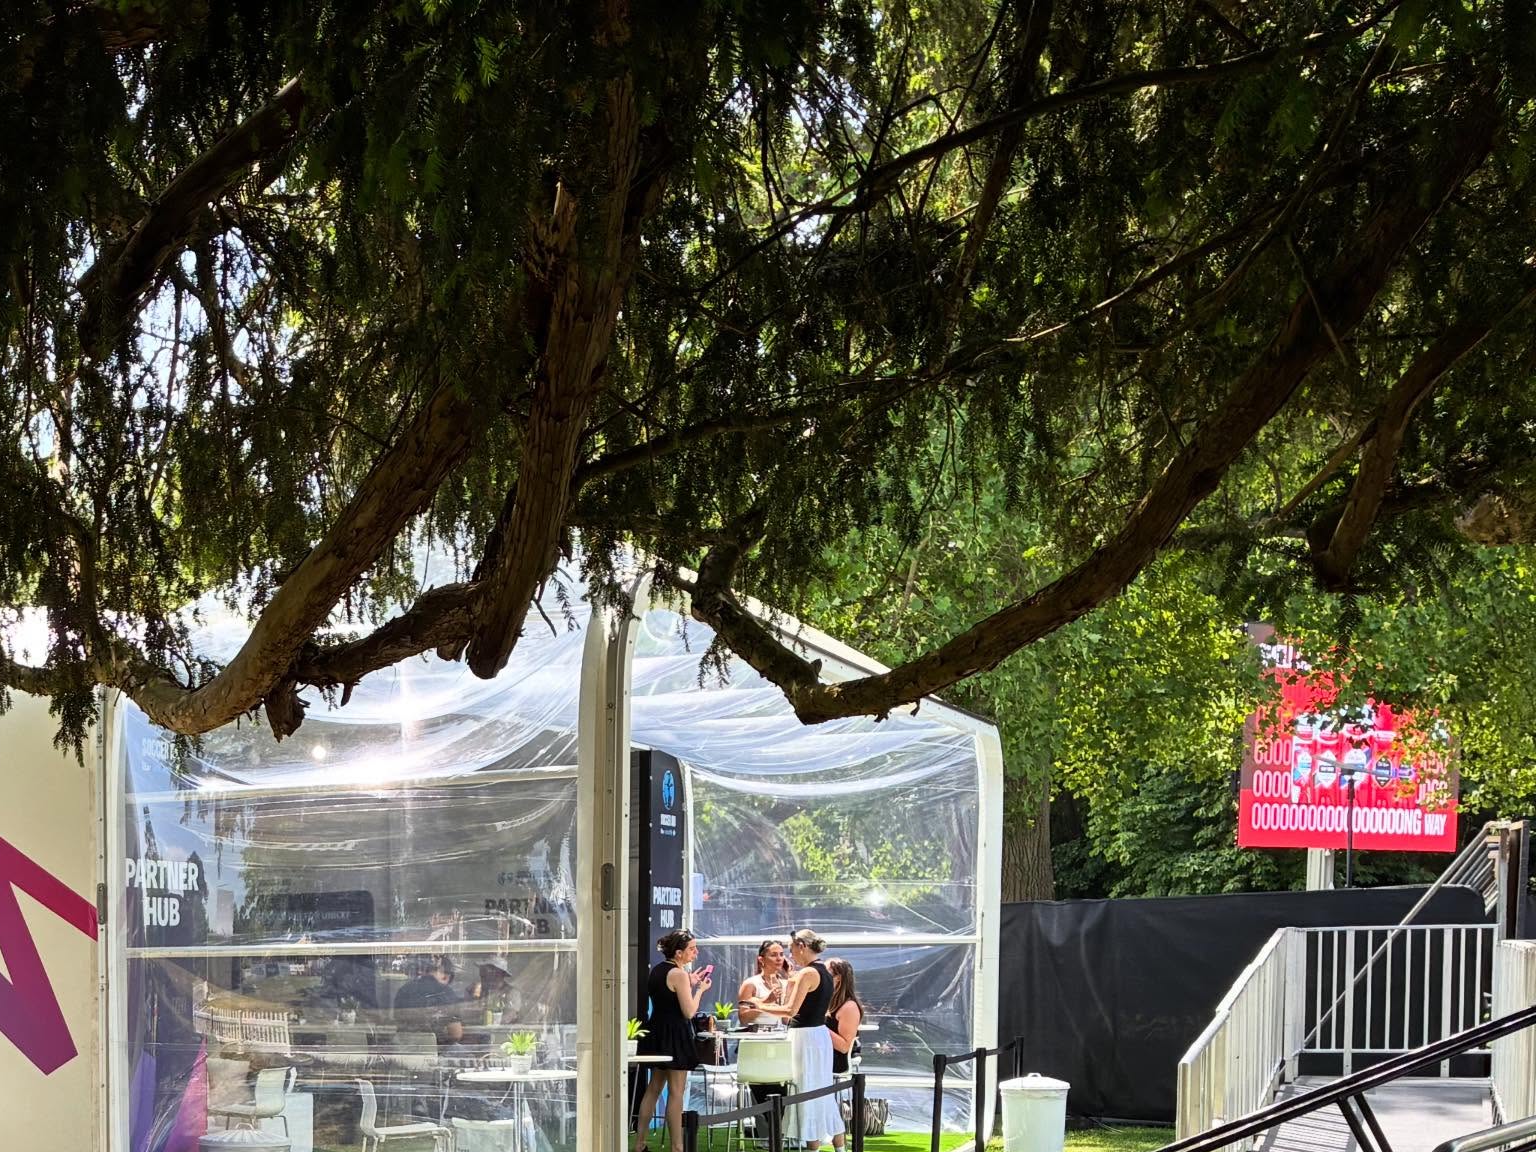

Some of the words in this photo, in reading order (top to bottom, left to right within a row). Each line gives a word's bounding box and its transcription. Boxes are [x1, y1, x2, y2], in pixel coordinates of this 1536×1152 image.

[1423, 813, 1447, 836] WAY
[124, 858, 199, 891] PARTNER
[652, 885, 682, 907] PARTNER
[144, 897, 181, 927] HUB
[660, 908, 675, 929] HUB
